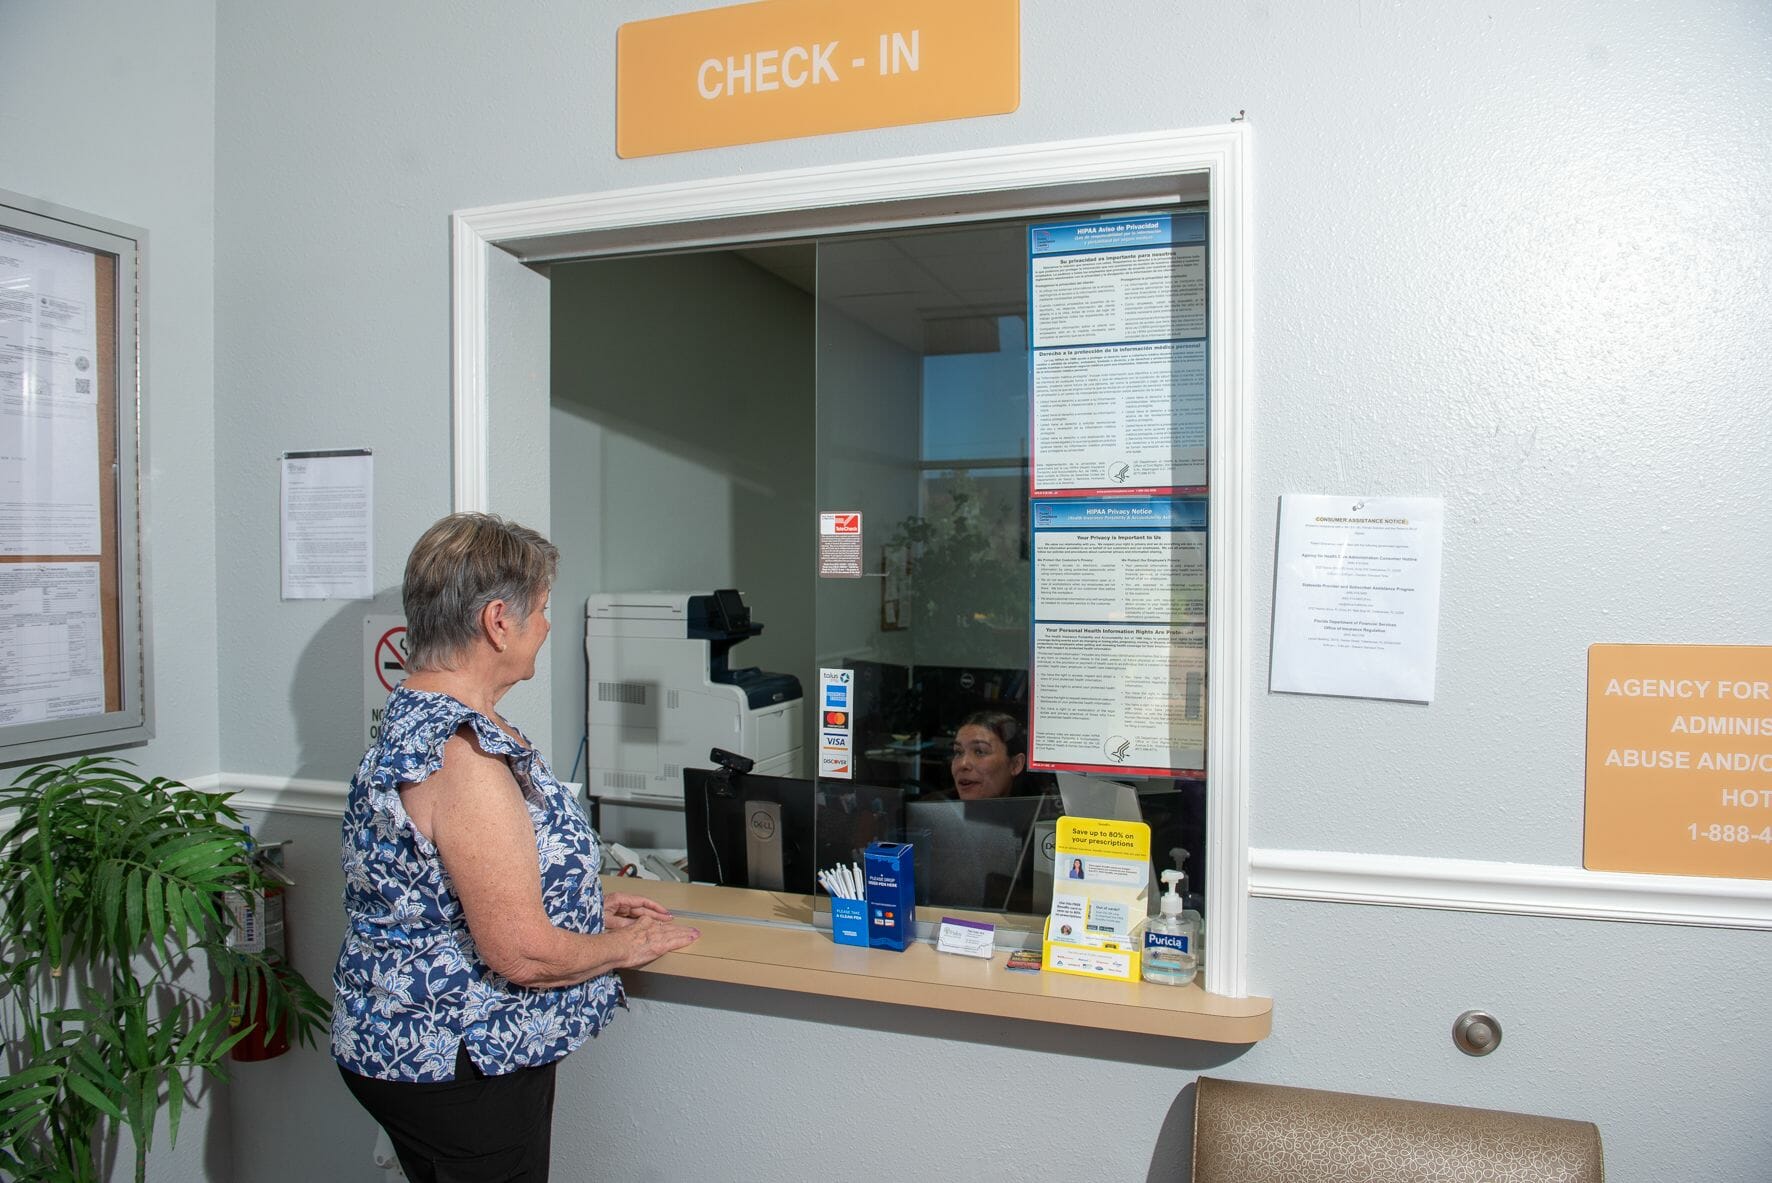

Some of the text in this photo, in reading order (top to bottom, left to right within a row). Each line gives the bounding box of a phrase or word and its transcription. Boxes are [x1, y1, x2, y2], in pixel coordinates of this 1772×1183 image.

[697, 29, 921, 100] CHECK - IN
[1077, 227, 1097, 235] HIPAA
[1126, 221, 1159, 231] Privacidad
[1068, 256, 1097, 265] privacidad
[1106, 254, 1137, 263] importante
[1074, 348, 1104, 357] protección
[1175, 343, 1201, 351] personal
[1107, 508, 1130, 516] Privacy
[1604, 678, 1770, 700] AGENCY FOR
[1670, 715, 1772, 737] ADMINIS
[827, 737, 846, 746] VISA
[1604, 748, 1691, 770] ABUSE
[1721, 788, 1772, 808] HOT
[753, 820, 773, 831] DELL
[1072, 827, 1088, 835] Save
[1108, 831, 1124, 839] 80%
[1687, 822, 1772, 844] 1-888-4
[1088, 838, 1134, 848] prescriptions
[1148, 933, 1182, 948] Puricia
